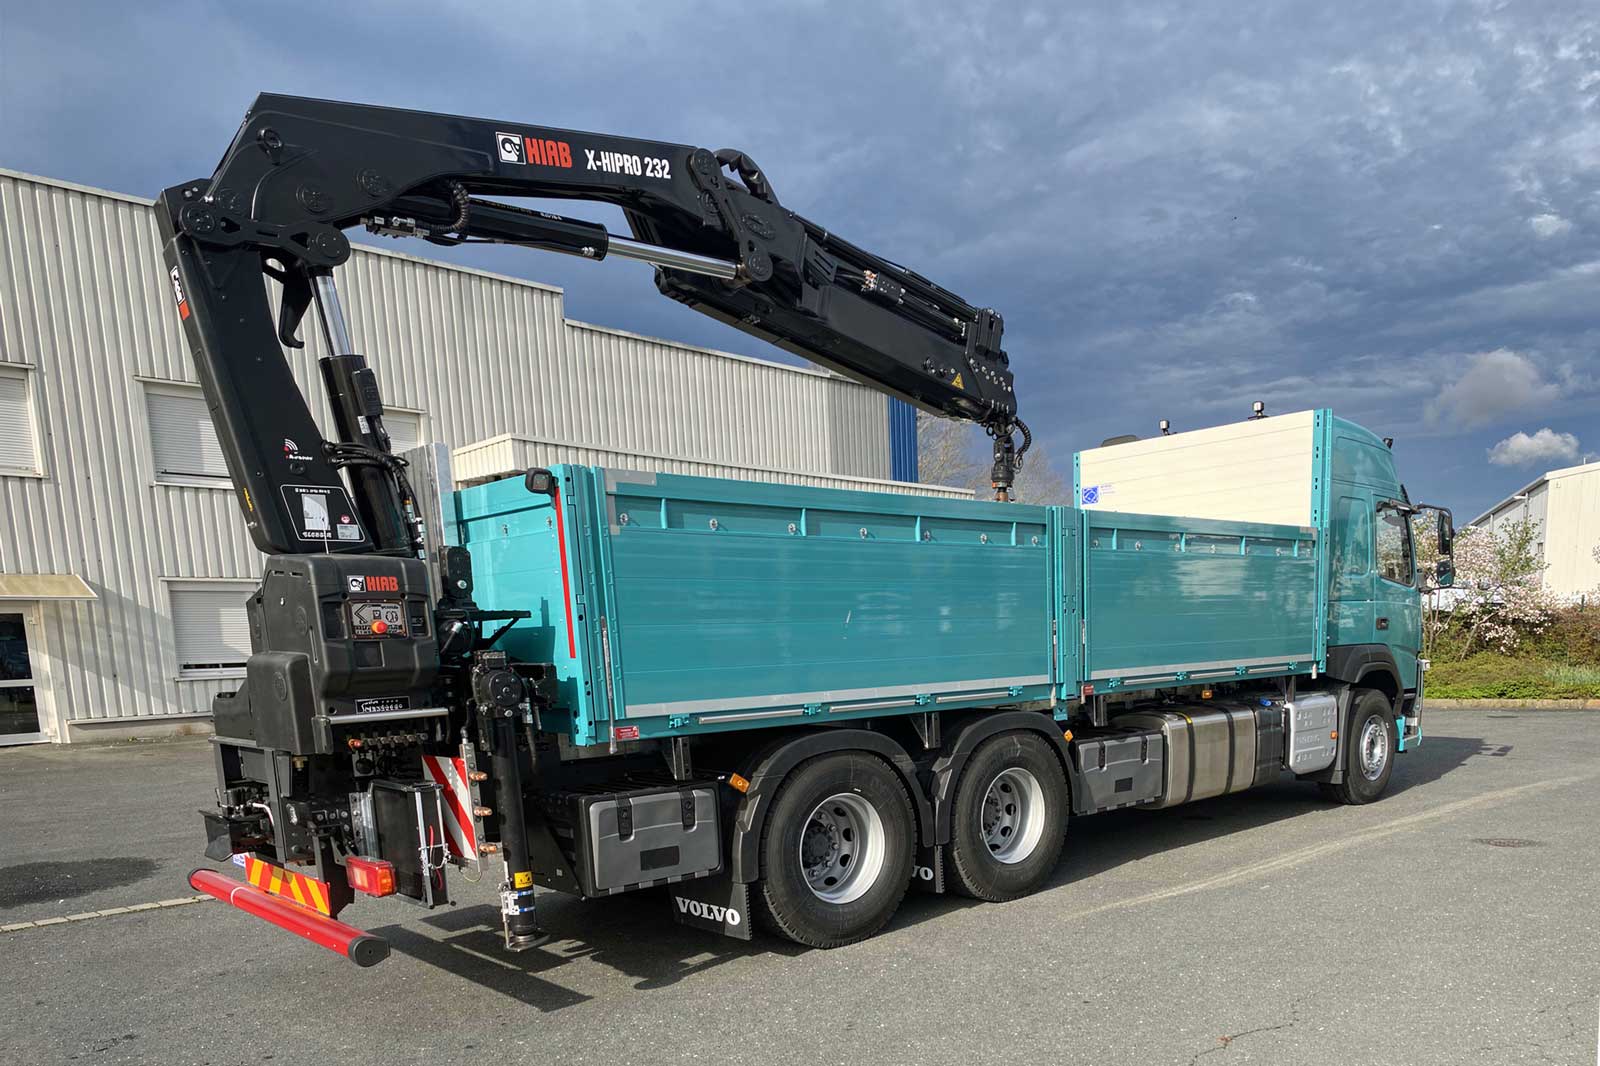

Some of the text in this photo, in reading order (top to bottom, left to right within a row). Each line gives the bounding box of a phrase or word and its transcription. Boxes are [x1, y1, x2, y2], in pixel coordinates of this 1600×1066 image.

[525, 138, 572, 168] HIAB
[584, 148, 672, 179] X-HIPRO 232
[365, 575, 399, 592] HIAB
[675, 896, 741, 926] VOLVO
